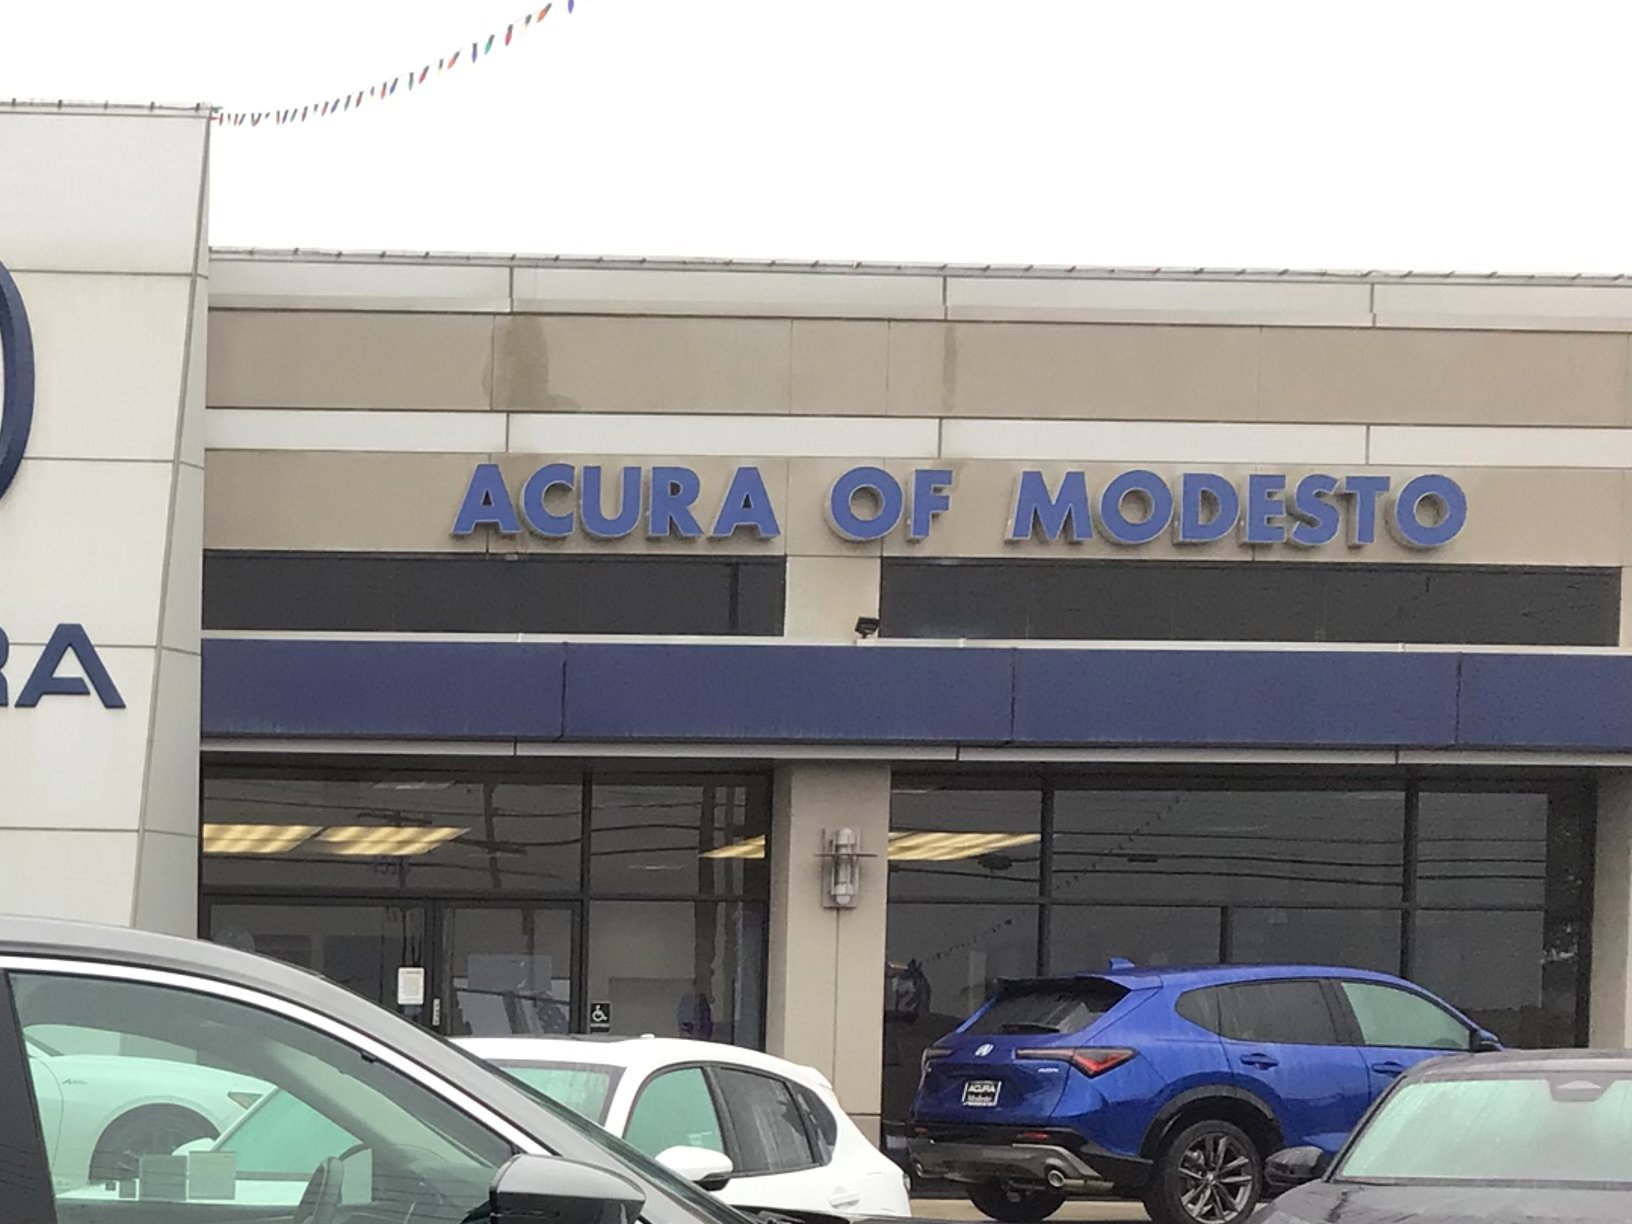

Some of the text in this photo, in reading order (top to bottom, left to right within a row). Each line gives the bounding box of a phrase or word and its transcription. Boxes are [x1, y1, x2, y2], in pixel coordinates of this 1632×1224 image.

[451, 462, 1470, 551] ACURA OF MODESTO
[967, 1084, 996, 1092] ACURA
